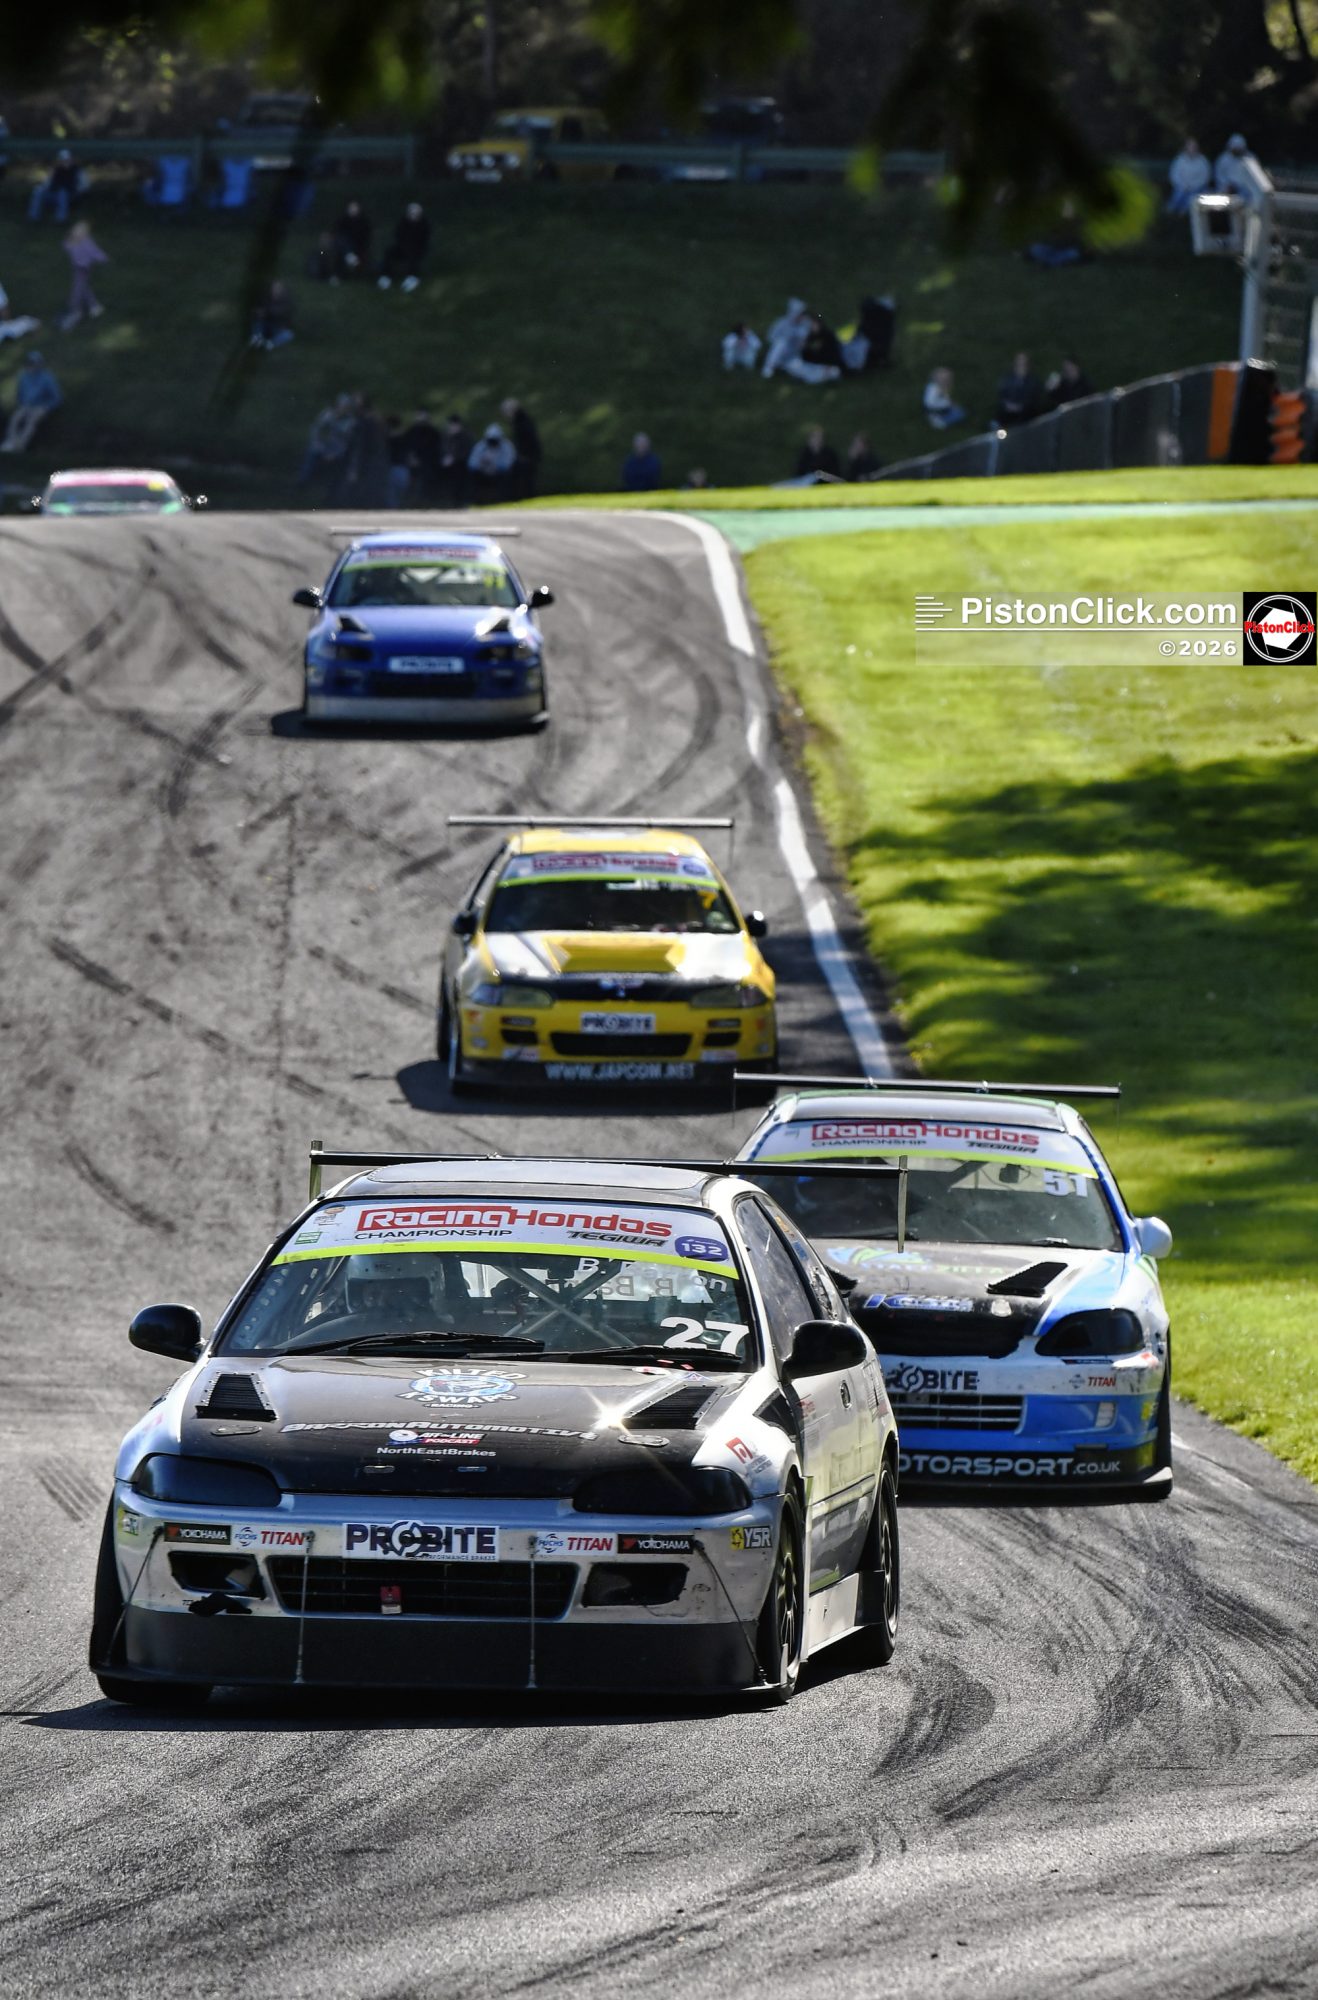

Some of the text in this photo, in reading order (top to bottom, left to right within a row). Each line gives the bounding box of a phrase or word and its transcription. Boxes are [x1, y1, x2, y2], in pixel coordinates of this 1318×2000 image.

[699, 891, 718, 909] 7
[811, 1139, 927, 1148] CHAMPIONSHIP
[1042, 1170, 1088, 1198] 51
[354, 1229, 513, 1240] CHAMPIONSHIP
[566, 1231, 669, 1247] TEGIWA
[681, 1243, 723, 1256] 132
[660, 1316, 750, 1356] 27
[415, 1368, 527, 1380] KILTED
[1088, 1376, 1117, 1387] TITAN
[377, 1446, 497, 1458] NorthEastBrakes
[179, 1528, 228, 1540] YOKOHAMA
[260, 1530, 305, 1546] TITAN
[346, 1520, 496, 1557] PROBITE
[744, 1527, 771, 1548] YSR
[538, 1539, 564, 1547] FUCHS
[567, 1537, 613, 1551] TITAN
[637, 1539, 690, 1549] YOKOHAMA
